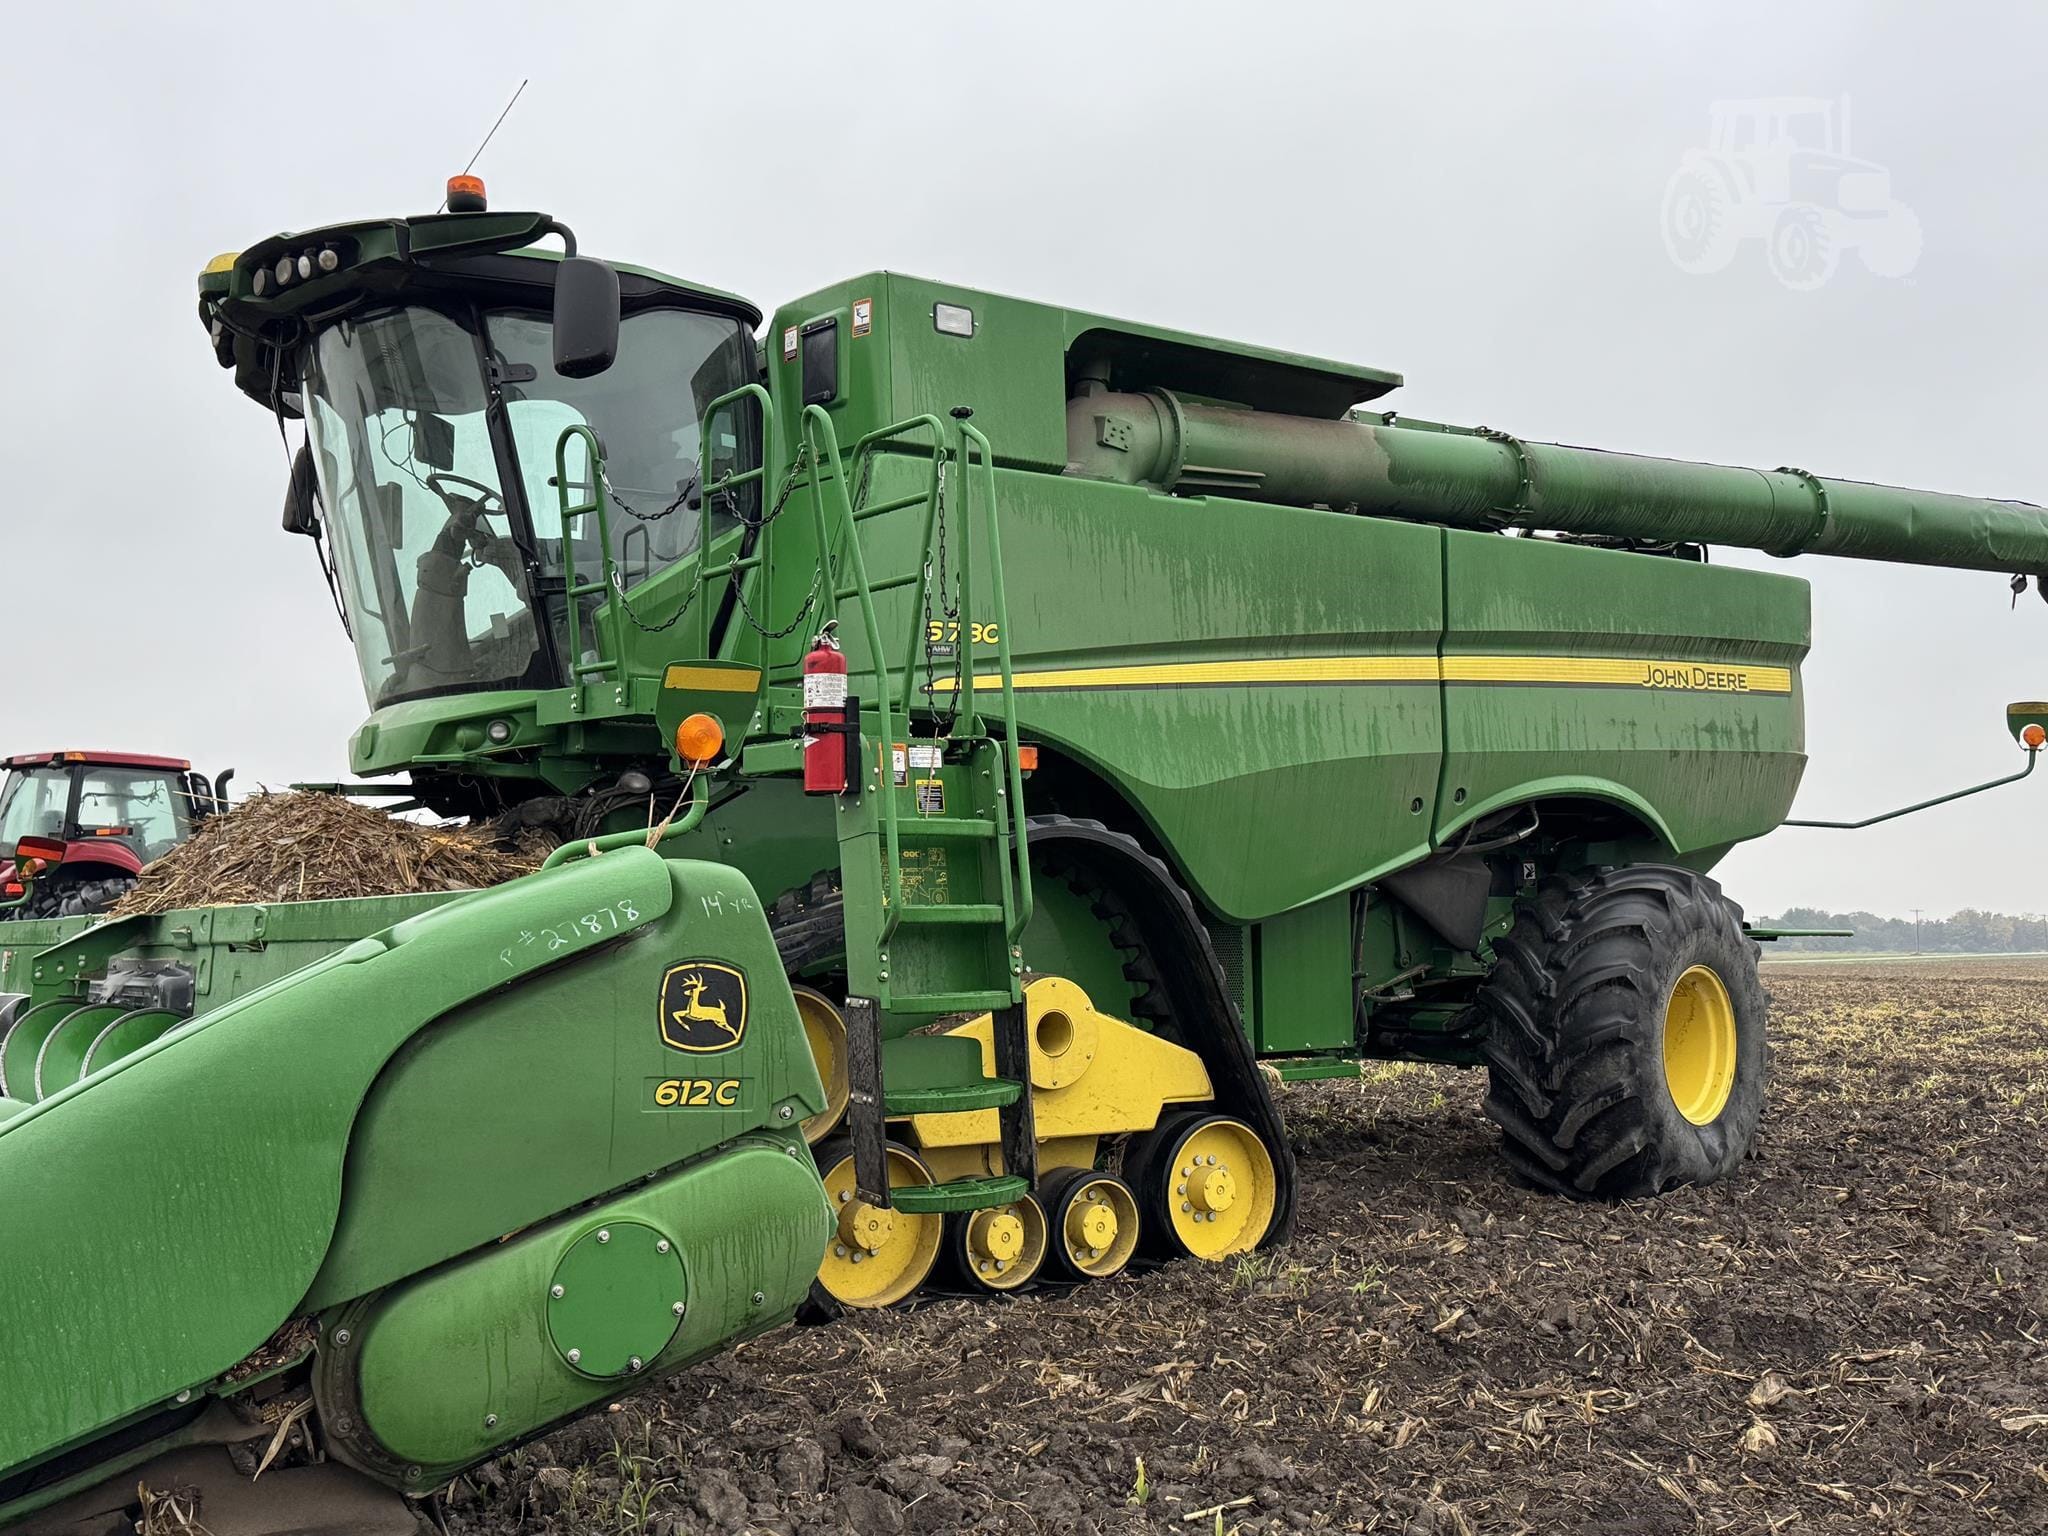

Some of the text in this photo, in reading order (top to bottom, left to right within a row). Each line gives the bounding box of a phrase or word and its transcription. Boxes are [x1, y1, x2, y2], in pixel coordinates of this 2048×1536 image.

[1642, 664, 1748, 690] JOHN DEERE
[654, 1079, 741, 1107] 612C
